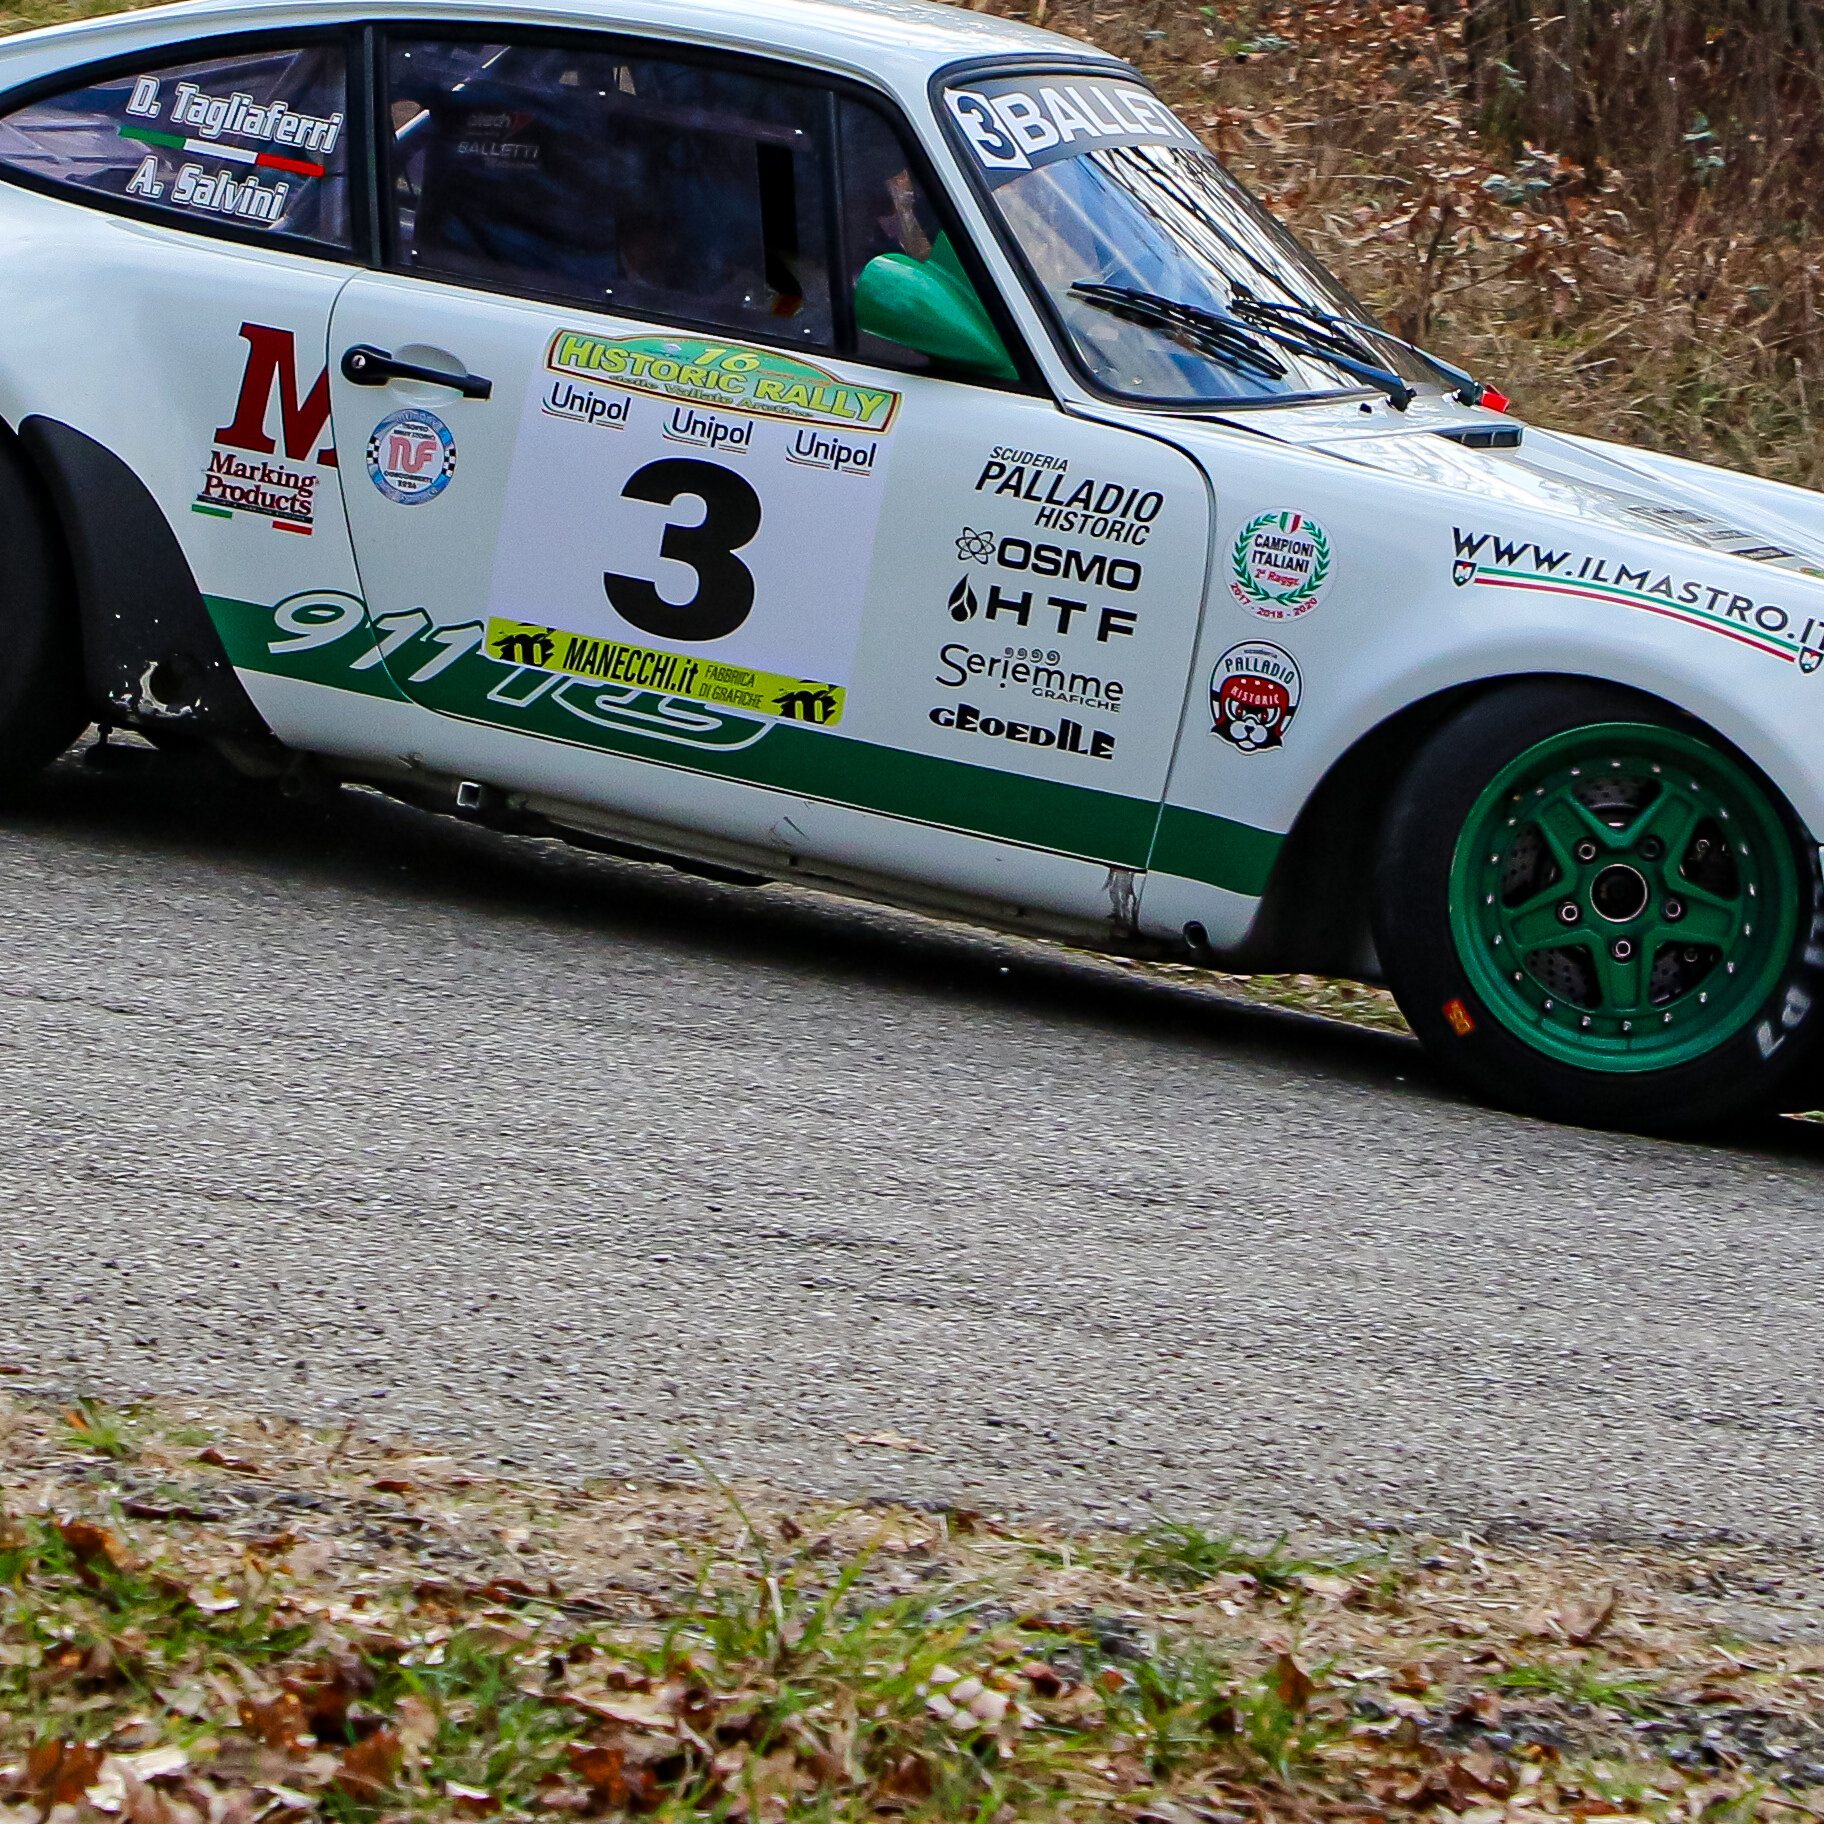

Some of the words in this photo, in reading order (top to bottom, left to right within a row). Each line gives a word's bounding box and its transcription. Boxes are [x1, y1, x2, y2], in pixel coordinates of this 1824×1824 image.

[126, 75, 161, 118] D.
[171, 82, 343, 154] Tagliaferri
[957, 95, 1016, 160] 3
[126, 156, 164, 198] A.
[171, 163, 289, 223] Salvini
[558, 336, 748, 394] HISTORIC
[754, 379, 885, 423] RALLY
[692, 347, 761, 374] 16
[551, 382, 632, 423] Unipol
[671, 406, 755, 449] Unipol
[794, 428, 877, 472] Unipol
[989, 445, 1069, 472] SCUDERIA
[202, 474, 313, 516] Products
[207, 450, 317, 498] Marking
[974, 460, 1165, 523] PALLADIO
[1034, 506, 1151, 546] HISTORIC
[1254, 534, 1315, 557] CAMPIONI
[602, 456, 763, 643] 3
[996, 536, 1143, 592] OSMO
[1252, 550, 1310, 573] ITALIANI
[268, 588, 486, 683] 911
[562, 637, 699, 694] MANECCHI.it
[704, 664, 756, 688] FABBRICA
[1225, 657, 1295, 684] PALLADIO
[698, 683, 711, 697] DI
[711, 686, 764, 709] GRAFICHE
[1031, 687, 1121, 713] GRAFICHE
[1231, 686, 1280, 705] HISTORIC
[929, 703, 1115, 760] GEOEDILE
